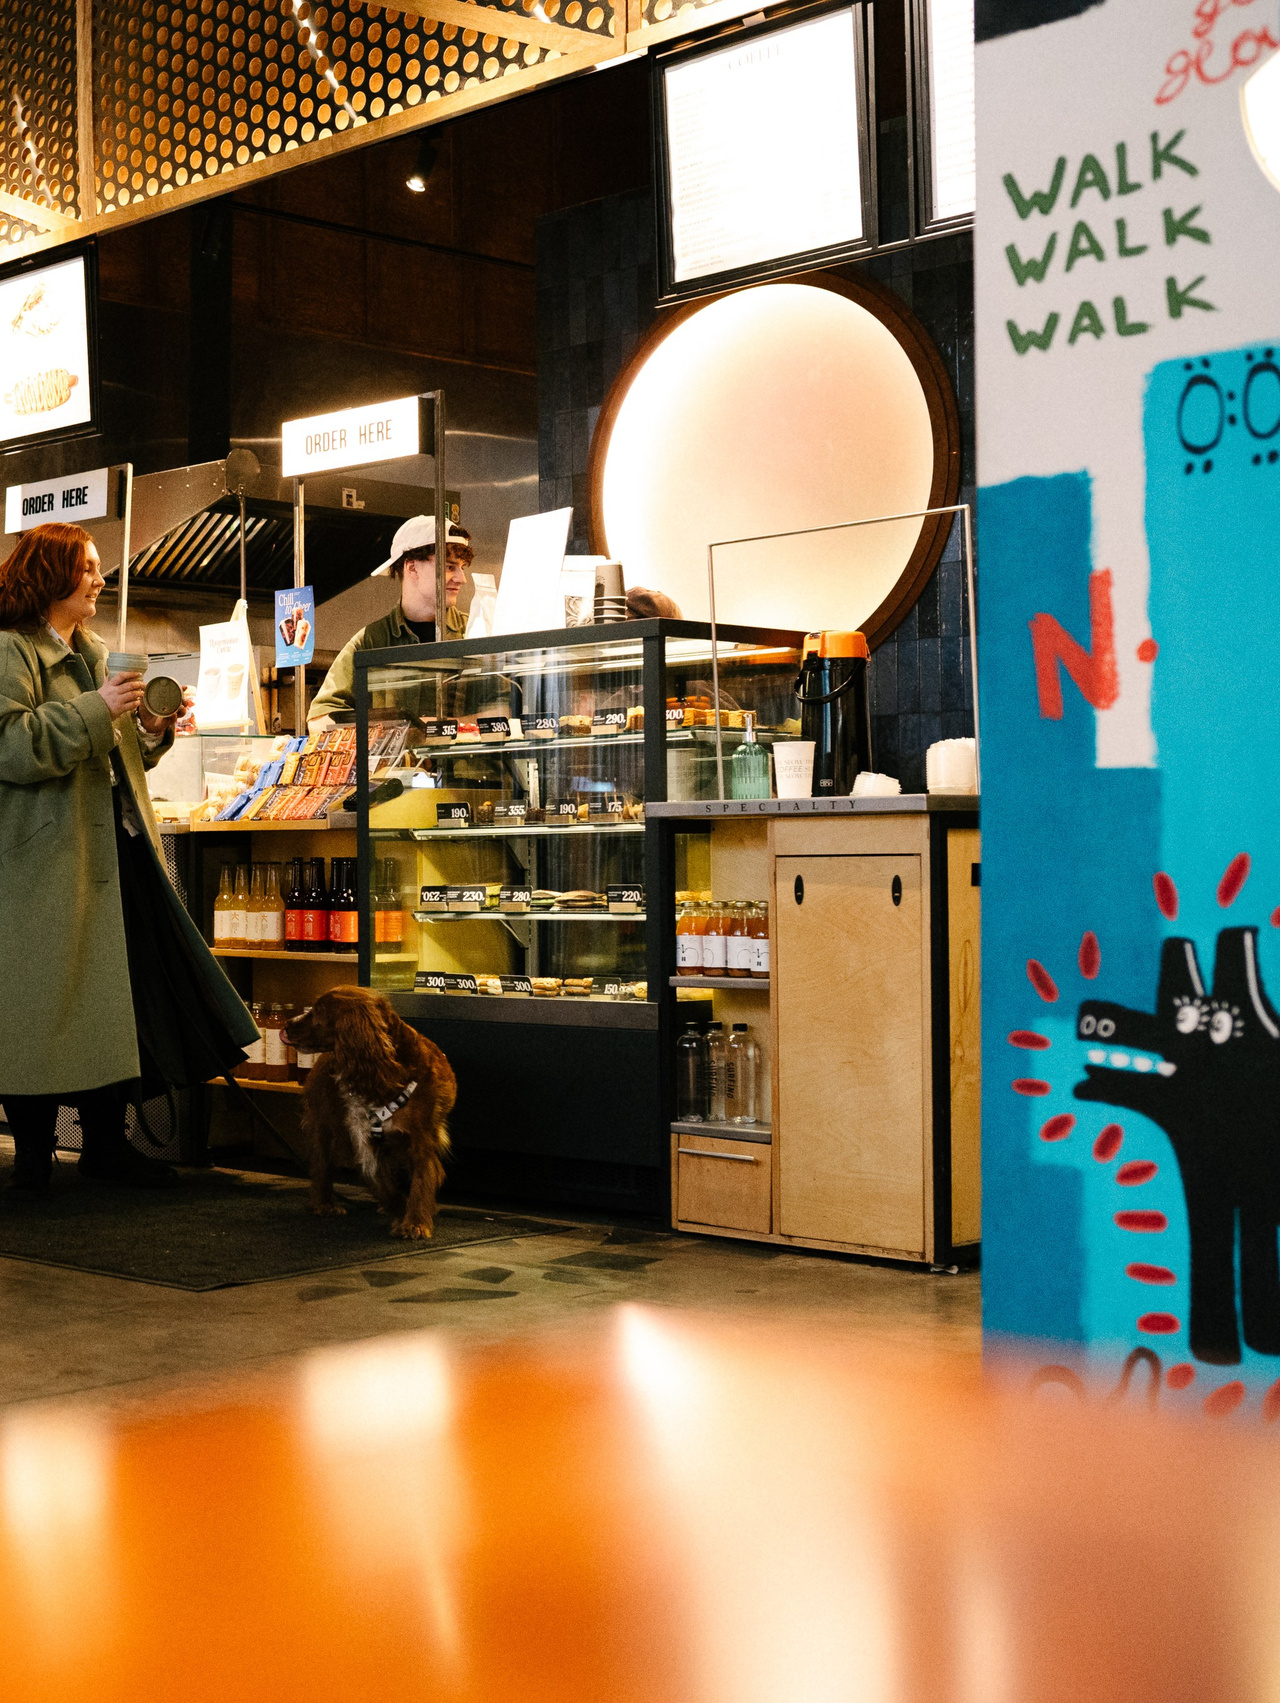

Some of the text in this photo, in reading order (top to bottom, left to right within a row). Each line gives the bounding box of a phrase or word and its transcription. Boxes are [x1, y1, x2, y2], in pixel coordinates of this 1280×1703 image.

[1002, 128, 1200, 221] WALK
[1004, 204, 1212, 287] WALK
[1005, 275, 1218, 355] WALK
[306, 419, 392, 455] ORDER HERE
[22, 486, 88, 516] ORDER HERE
[278, 592, 294, 607] Chill
[705, 799, 857, 814] SPECIALTY
[726, 1061, 736, 1099] SURFING
